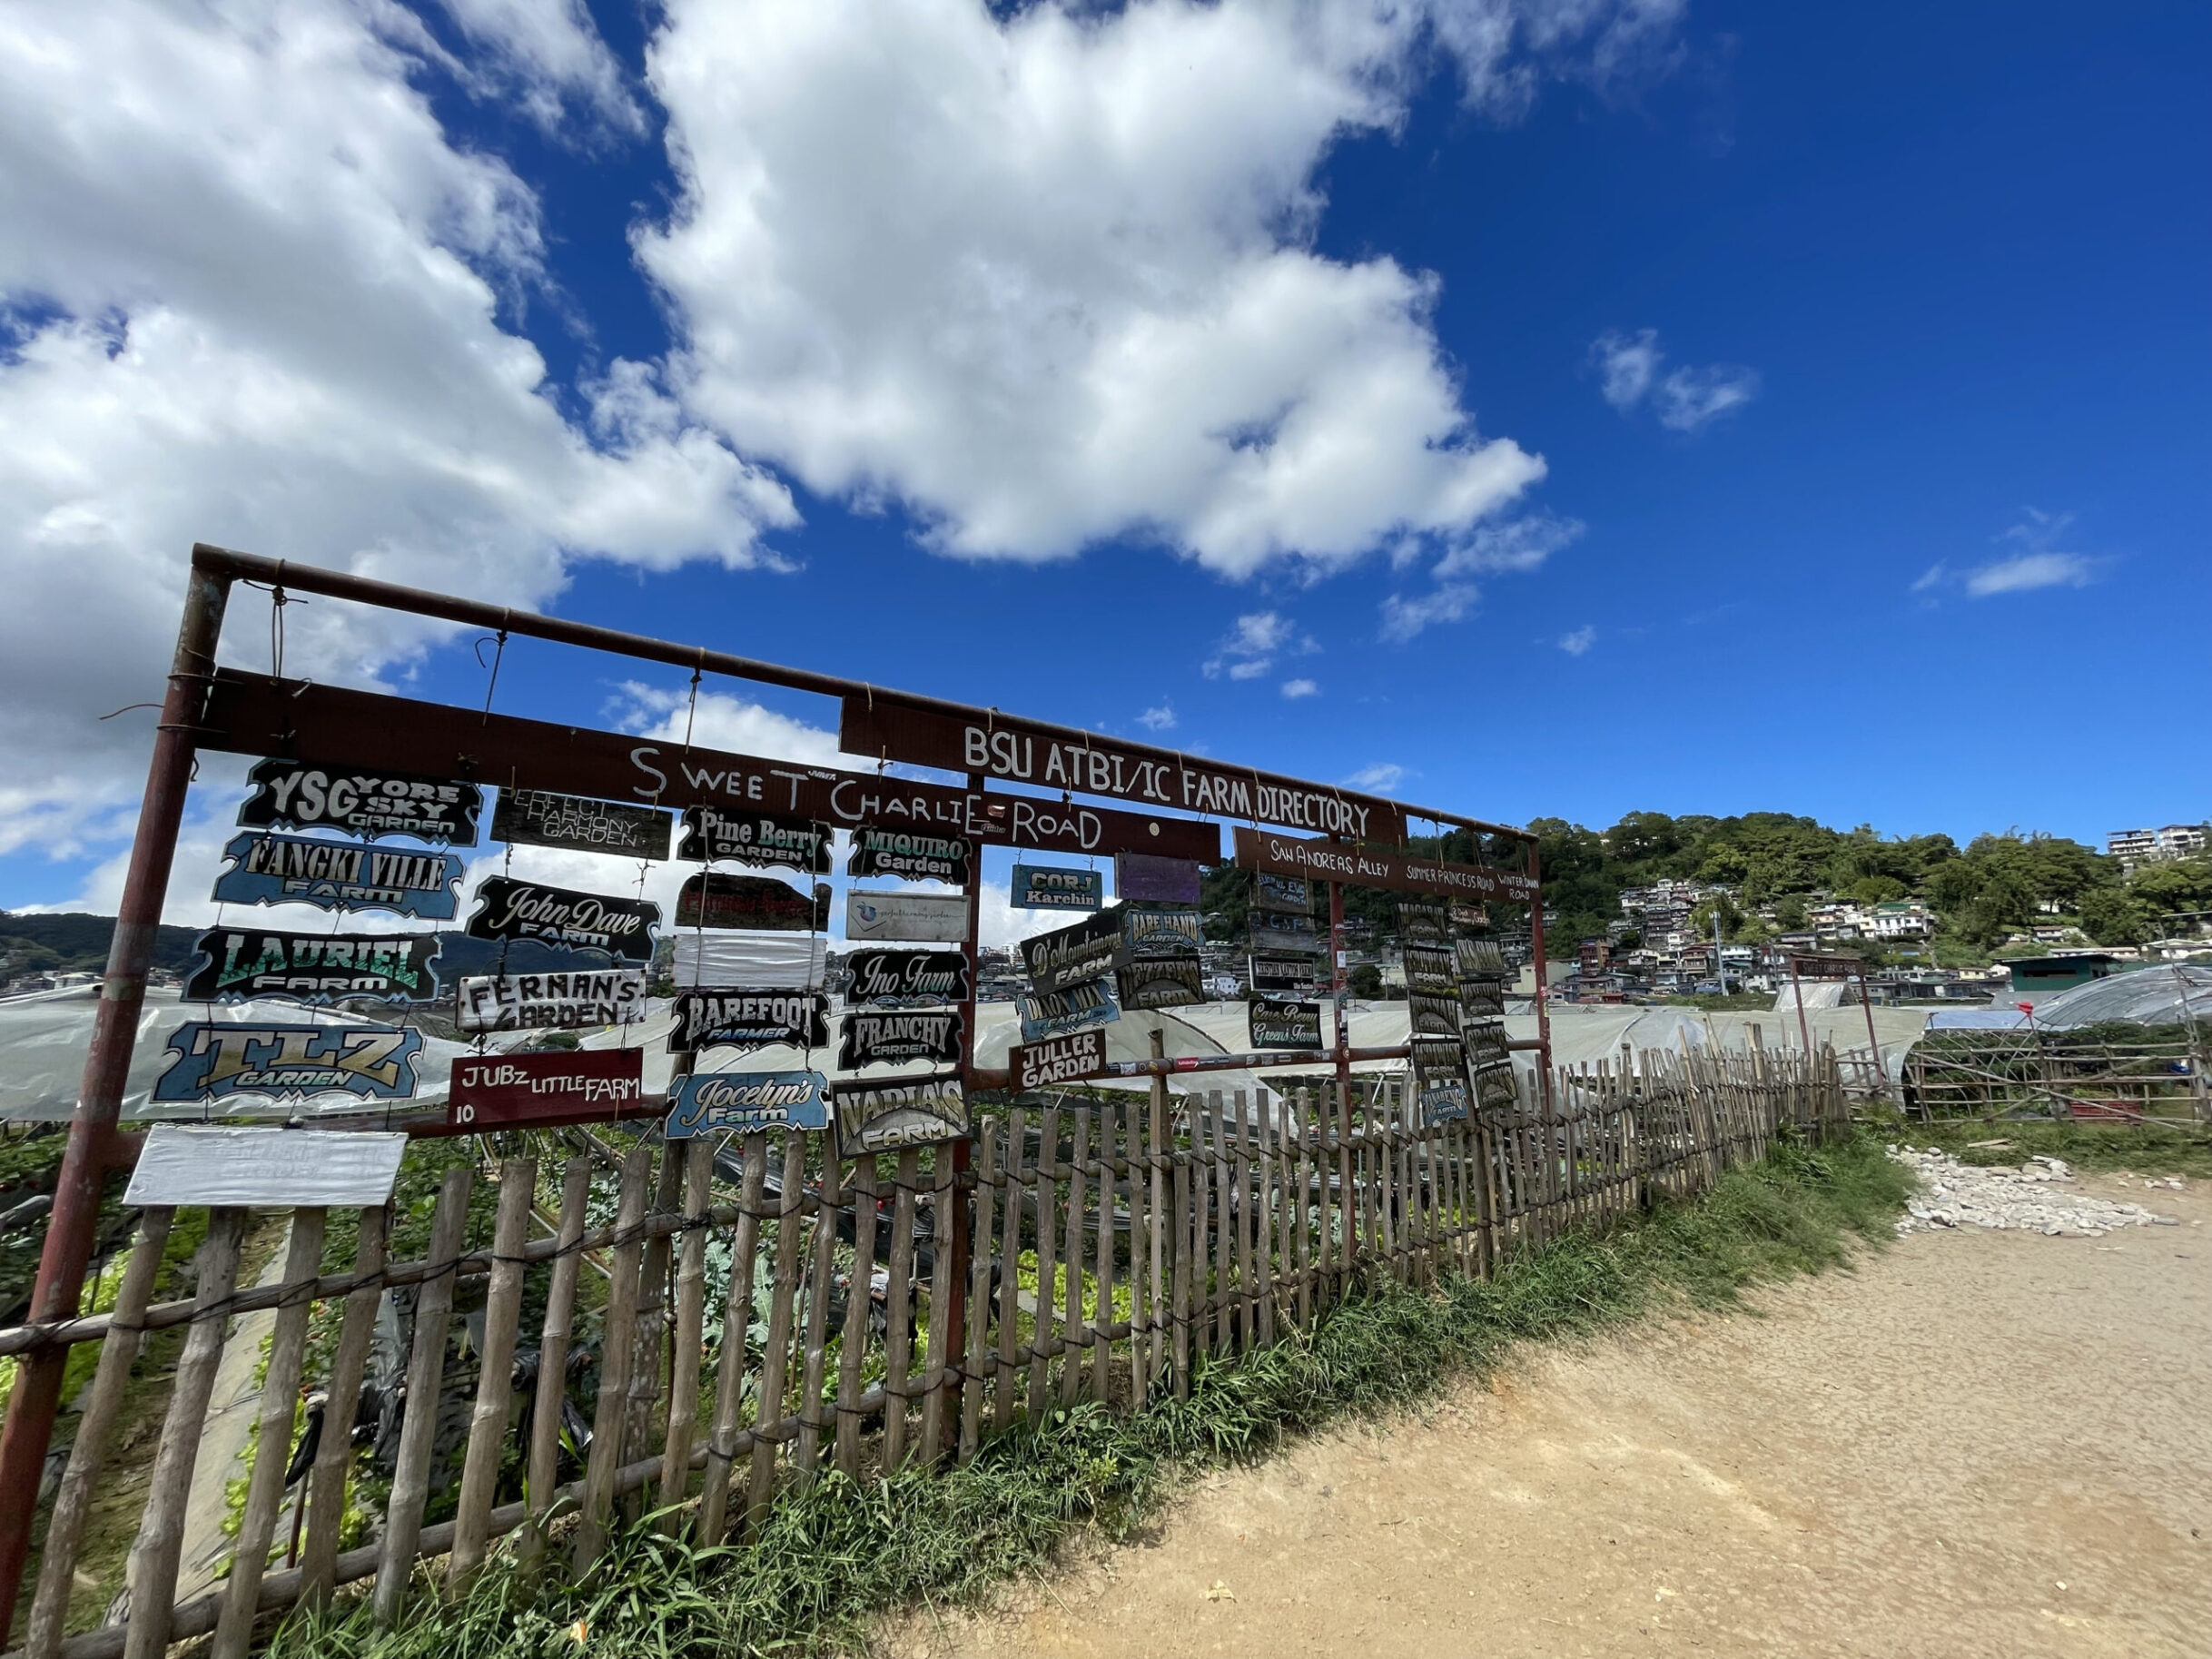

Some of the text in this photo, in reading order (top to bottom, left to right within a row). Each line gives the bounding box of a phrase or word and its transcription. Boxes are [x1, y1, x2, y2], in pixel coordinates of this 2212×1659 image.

[270, 771, 359, 820] YSG
[351, 776, 459, 804] YORE
[964, 726, 1369, 837] BSU ATBI/IC FARM DIRECTORY
[365, 796, 449, 819] SKY
[630, 747, 1101, 849] SWEET CHARLIE ROAD
[348, 813, 455, 834] GARDEN
[528, 806, 638, 833] HARMONY
[544, 822, 637, 847] GARDEN
[698, 811, 822, 857] Pine Berry
[864, 831, 963, 860] MIQUIRO
[716, 843, 803, 862] GARDEN
[875, 852, 952, 874] Garden
[1271, 840, 1389, 877] SAN ANDREAS ALLEY
[371, 853, 446, 891] VILLE
[1406, 864, 1495, 893] SUMMER PRINCESS ROAD
[1497, 873, 1523, 887] WINTER
[283, 881, 403, 903] FARM
[1026, 890, 1095, 906] Karchin
[1509, 888, 1530, 900] ROAD
[489, 887, 640, 933] John Dave
[519, 923, 609, 946] FARM
[1132, 914, 1199, 942] BARE HAND
[1142, 934, 1185, 943] GARDEN
[216, 934, 418, 989] LAURIEL
[856, 954, 957, 994] Ino Farm
[1054, 953, 1113, 986] FARM
[253, 977, 388, 990] FARM
[469, 974, 639, 1014] FERNAN'S
[1137, 989, 1190, 1008] FARM
[494, 1003, 617, 1030] GARDEN
[686, 998, 816, 1041] BAREFOOT
[1047, 1010, 1091, 1028] FARM
[706, 1027, 791, 1040] FARMER
[854, 1016, 952, 1058] FRANCHY
[193, 1030, 404, 1088] TLZ
[871, 1044, 929, 1055] GARDEN
[1022, 1033, 1097, 1069] JULLER
[236, 1071, 354, 1087] GARDEN
[1022, 1053, 1100, 1088] GARDEN
[531, 1075, 585, 1093] LITTLE
[585, 1078, 639, 1101] FARM
[680, 1079, 815, 1126] Jocelyn's
[707, 1107, 788, 1124] Farm
[836, 1081, 969, 1144] NADIA'S
[863, 1121, 947, 1150] FARM
